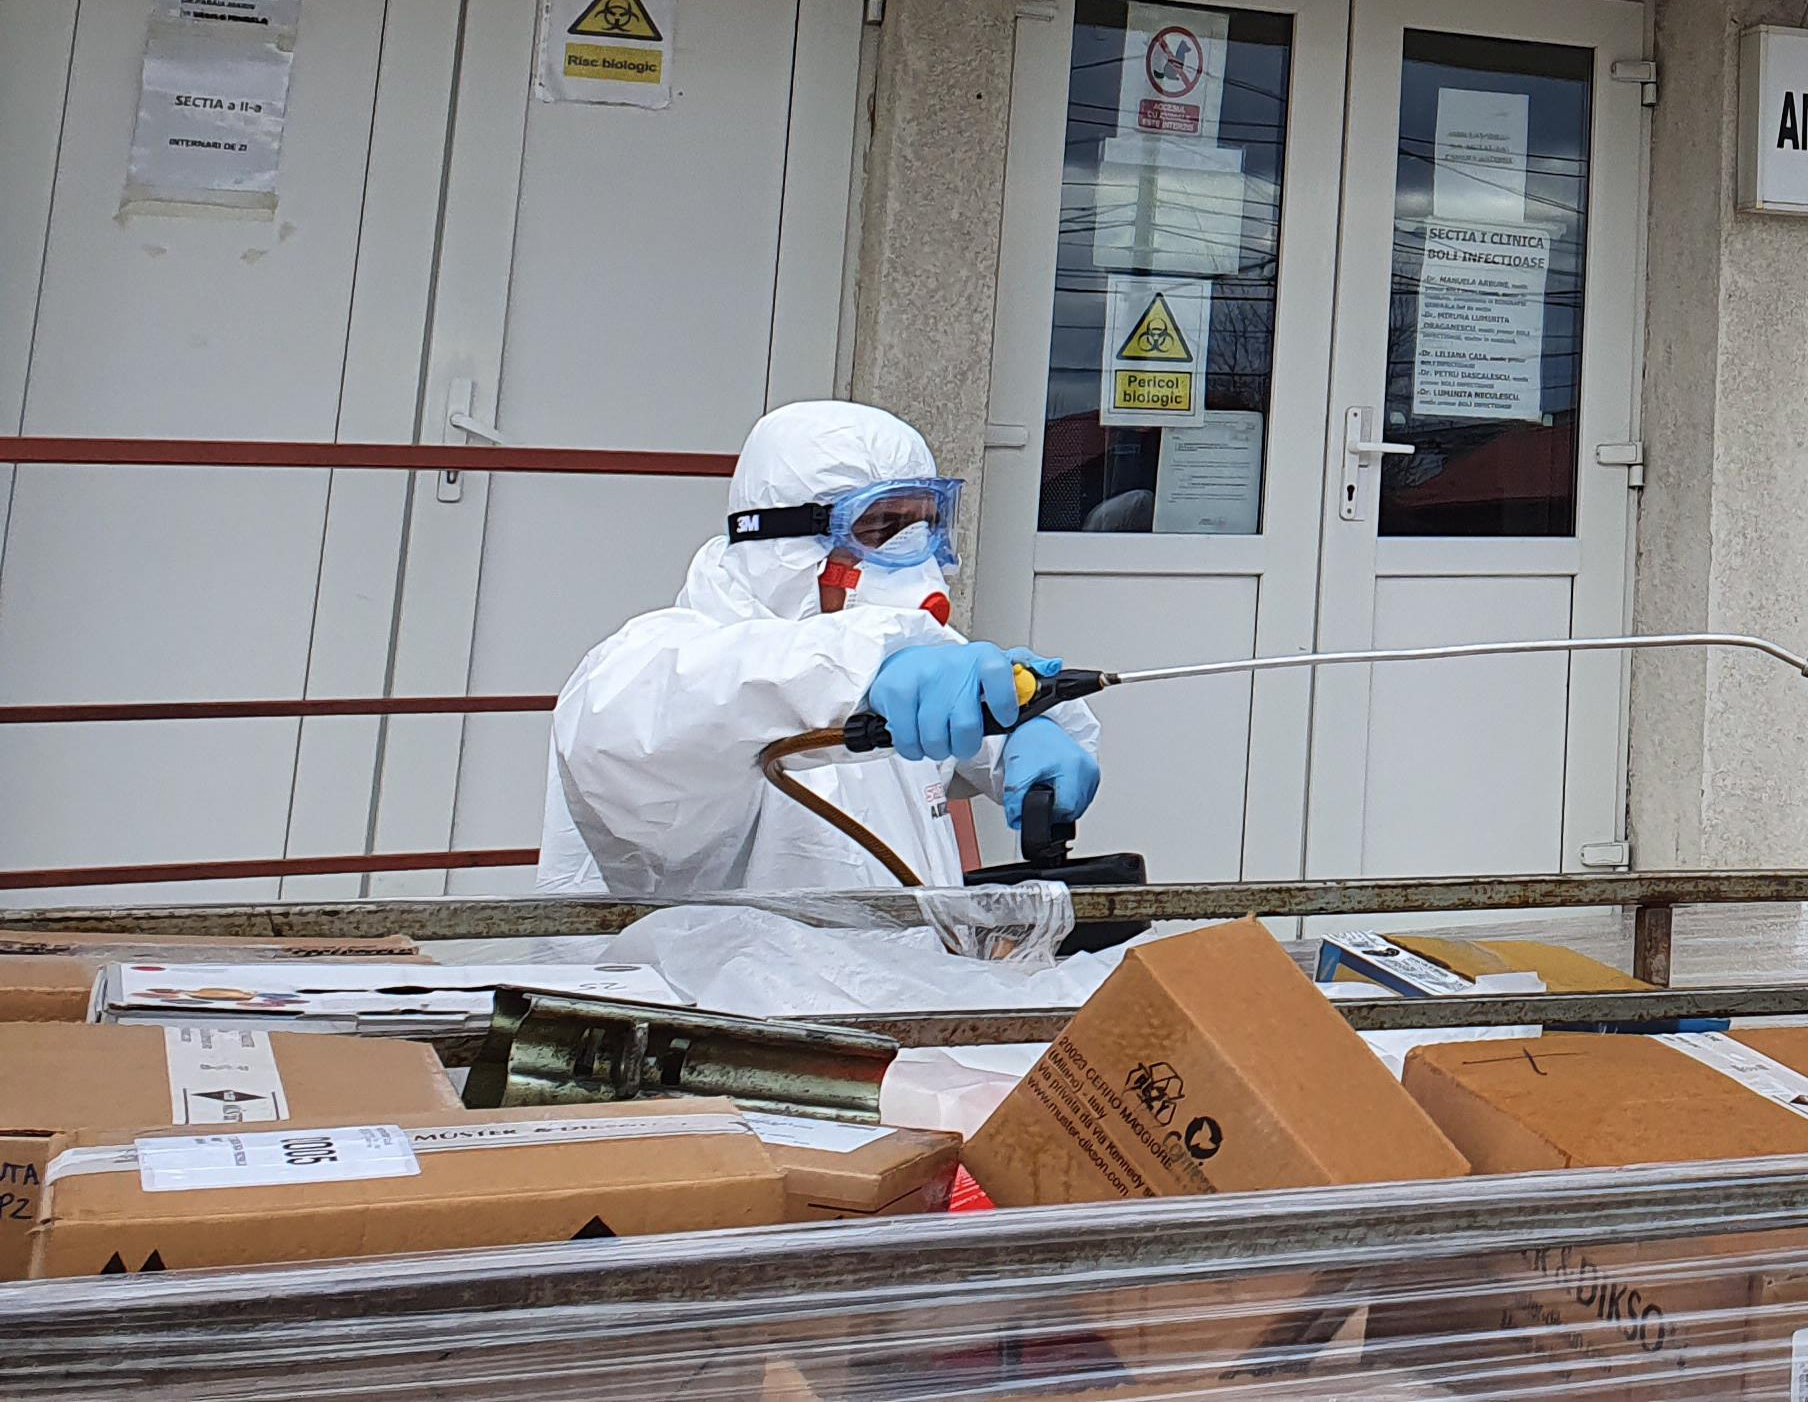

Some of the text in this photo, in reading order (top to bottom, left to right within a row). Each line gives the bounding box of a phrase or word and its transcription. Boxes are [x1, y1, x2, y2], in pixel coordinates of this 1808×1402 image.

[567, 54, 658, 74] Risc biologic
[174, 94, 224, 110] SECTIA
[1429, 227, 1545, 249] SECTIA I CLINICA
[1427, 248, 1546, 269] BOLI INFECTIOASE
[1127, 375, 1179, 389] Pericol
[1123, 390, 1183, 407] biologic
[736, 514, 760, 534] 3M
[1058, 1035, 1172, 1171] 20023 CERRO MAGGIORE
[1087, 1094, 1108, 1120] Italy
[1091, 1128, 1107, 1147] via
[1104, 1142, 1145, 1192] Kennedy
